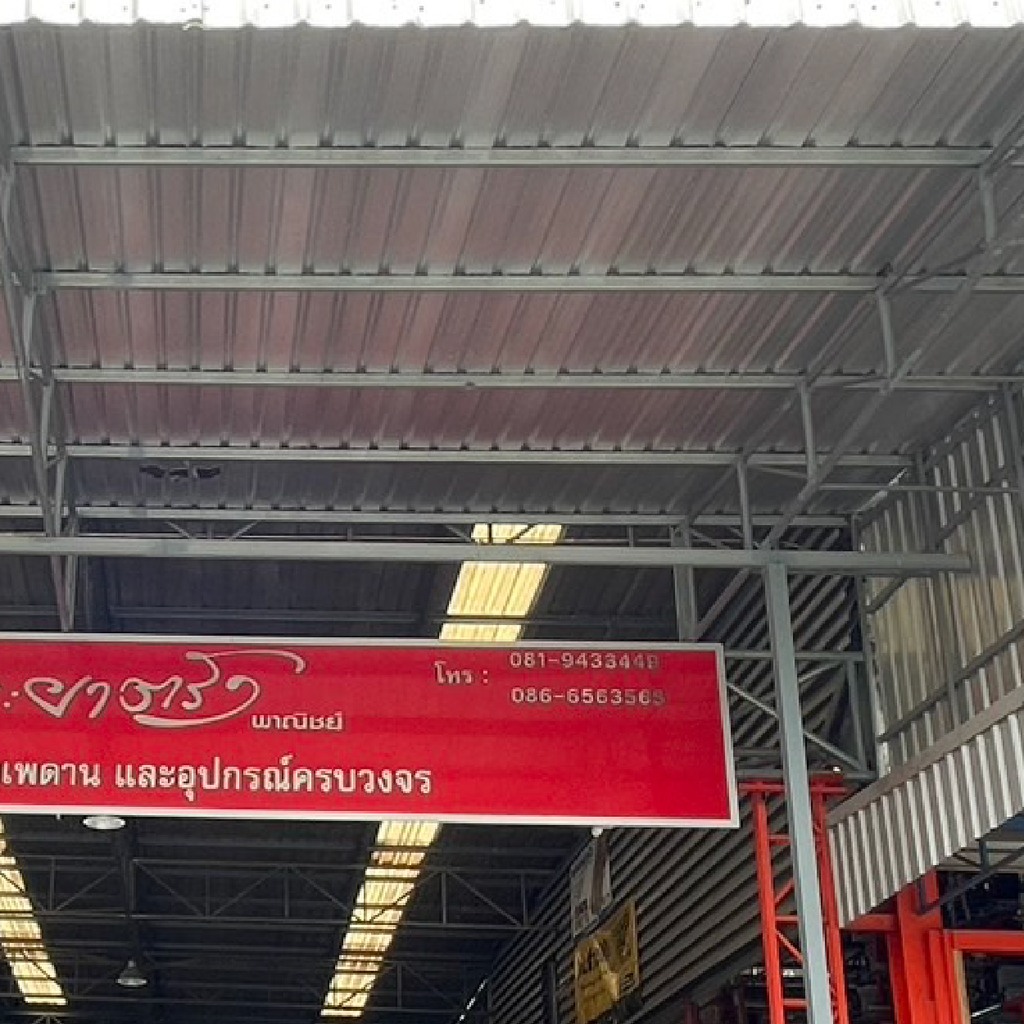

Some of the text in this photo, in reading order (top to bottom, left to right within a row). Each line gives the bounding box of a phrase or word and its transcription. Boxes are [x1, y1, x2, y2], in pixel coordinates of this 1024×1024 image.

[434, 661, 474, 684] โทร
[251, 710, 343, 732] พาณิชย์
[115, 754, 432, 801] และอุปกรณ์ครบวงจร
